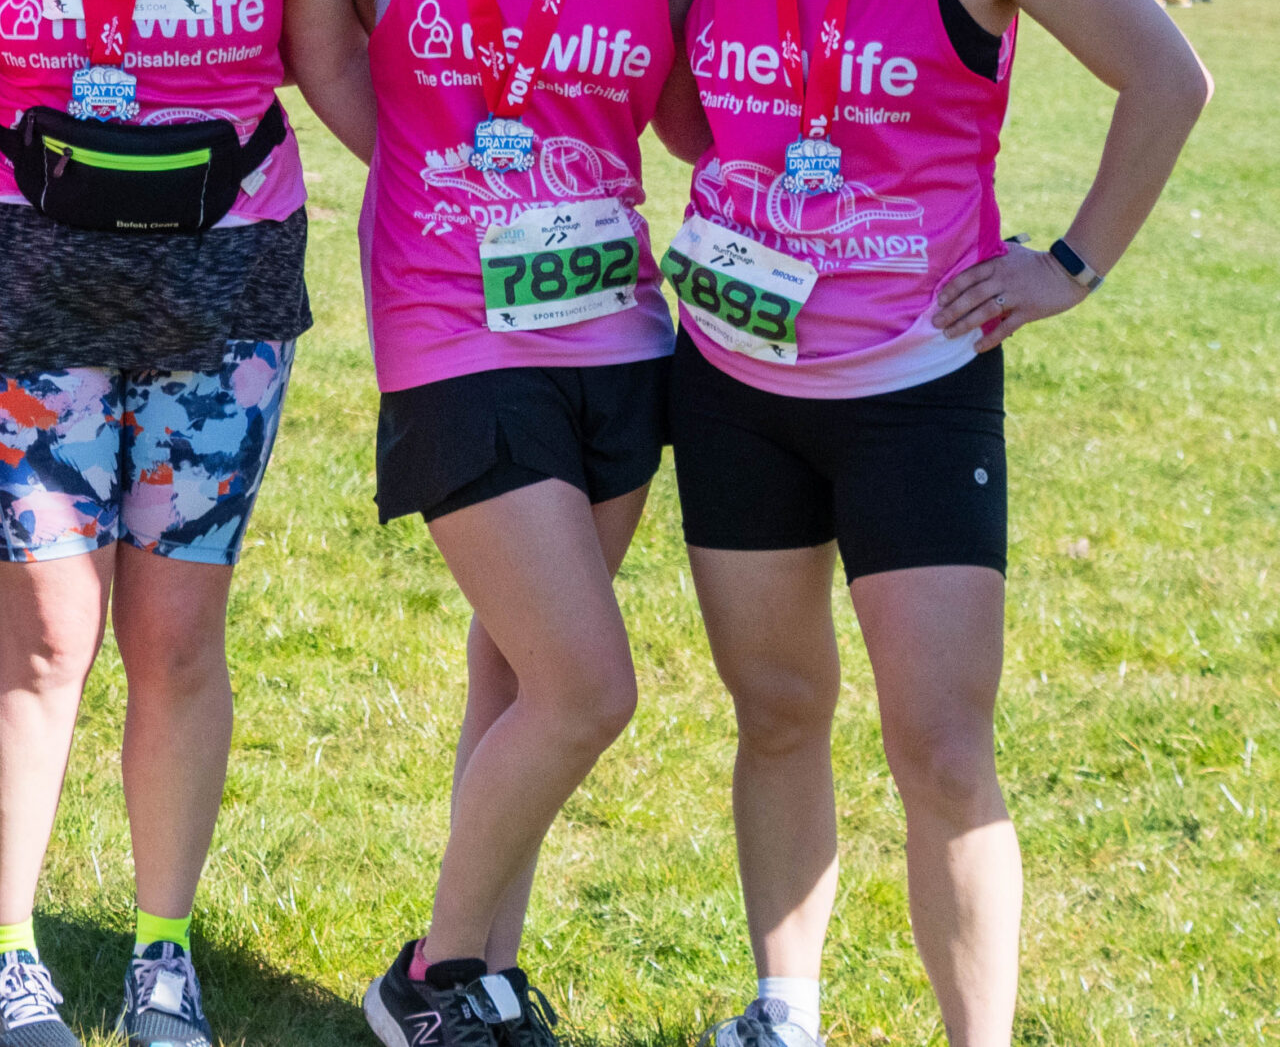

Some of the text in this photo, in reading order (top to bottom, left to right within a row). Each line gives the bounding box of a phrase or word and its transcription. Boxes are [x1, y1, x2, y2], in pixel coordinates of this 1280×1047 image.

[1, 44, 263, 71] The Charity Disabled Children
[718, 39, 919, 97] neife
[414, 69, 438, 87] The
[440, 69, 482, 87] Chari
[507, 62, 535, 106] 10K
[74, 85, 135, 97] DRAYTON
[746, 96, 770, 114] for
[843, 105, 912, 125] Children
[477, 137, 531, 149] DRAYTON
[789, 158, 840, 170] DRAYTON
[413, 210, 472, 225] RunThrough
[595, 217, 620, 227] BROOKS
[541, 222, 581, 234] RunThrough
[712, 244, 755, 266] RunThrough
[487, 240, 634, 305] 7892
[772, 268, 805, 285] BROOKS
[668, 250, 792, 341] 7893
